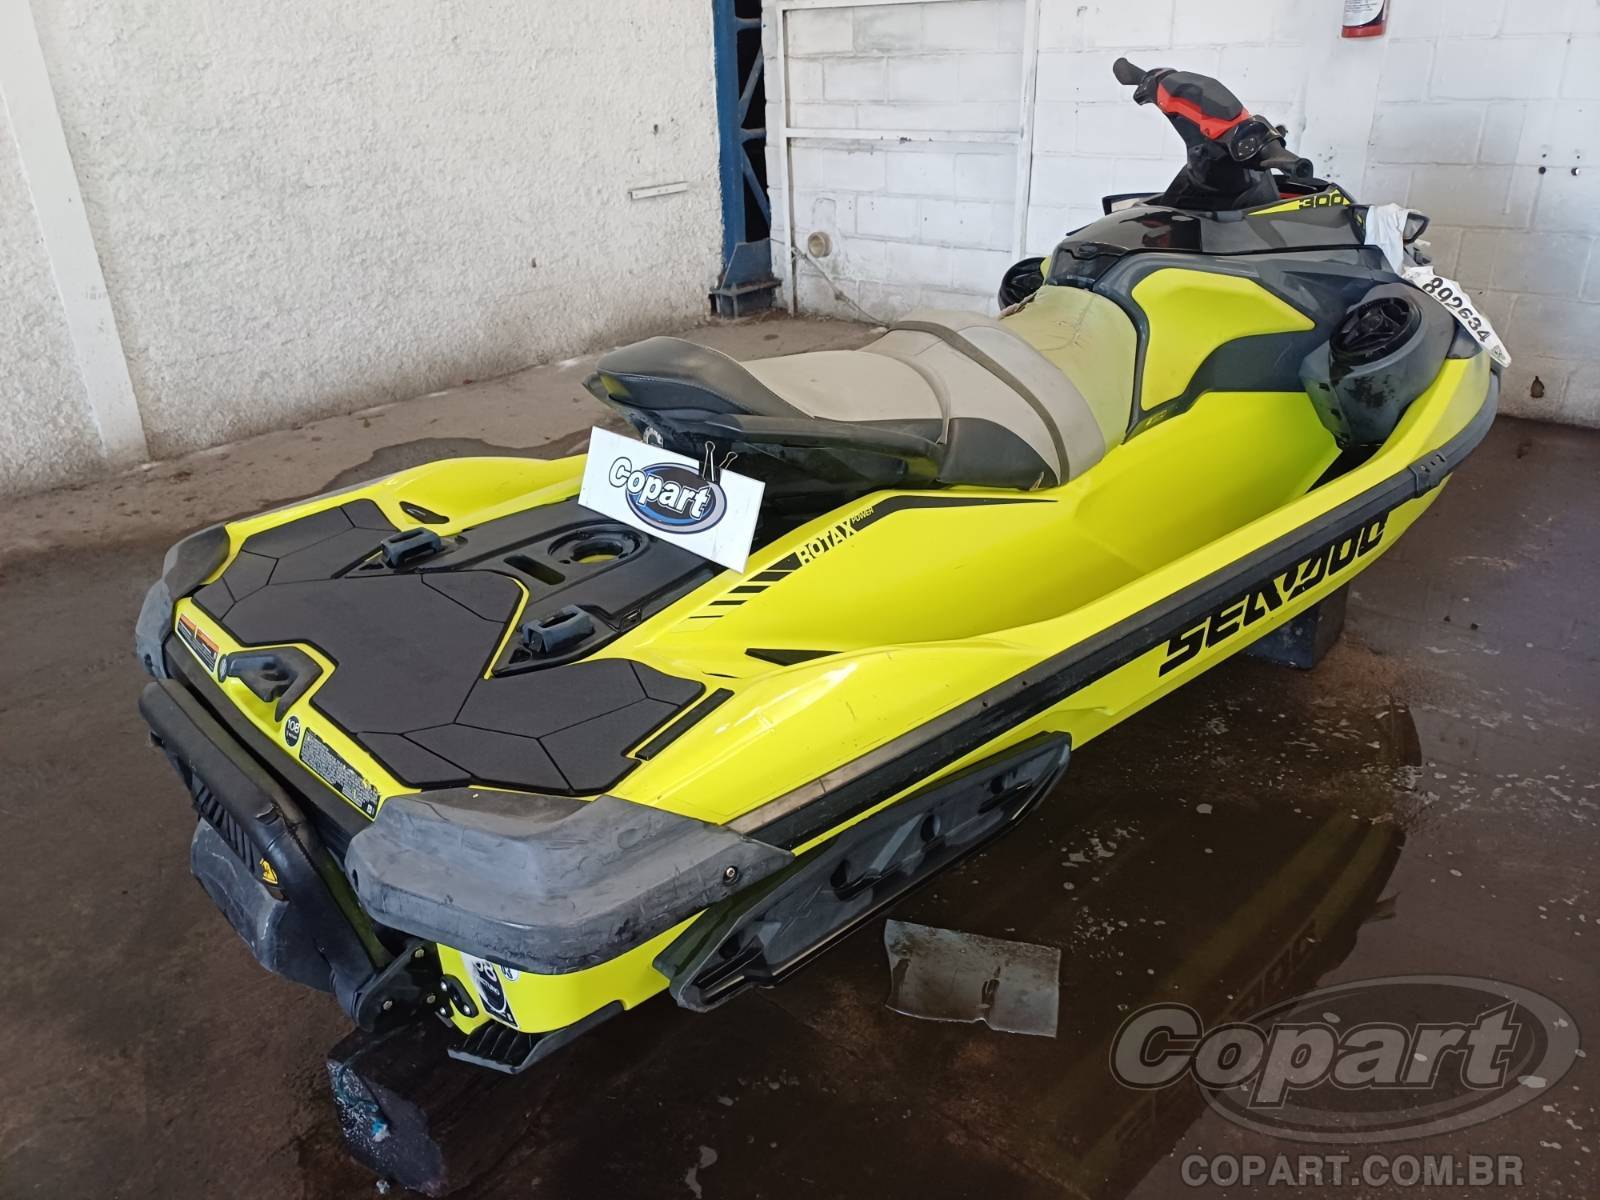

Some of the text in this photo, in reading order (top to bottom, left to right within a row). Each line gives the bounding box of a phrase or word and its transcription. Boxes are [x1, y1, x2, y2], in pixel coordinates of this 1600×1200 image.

[1299, 191, 1343, 208] 300
[1422, 277, 1491, 343] 892634
[609, 456, 712, 520] Copart
[796, 505, 875, 567] ROTAX POWER
